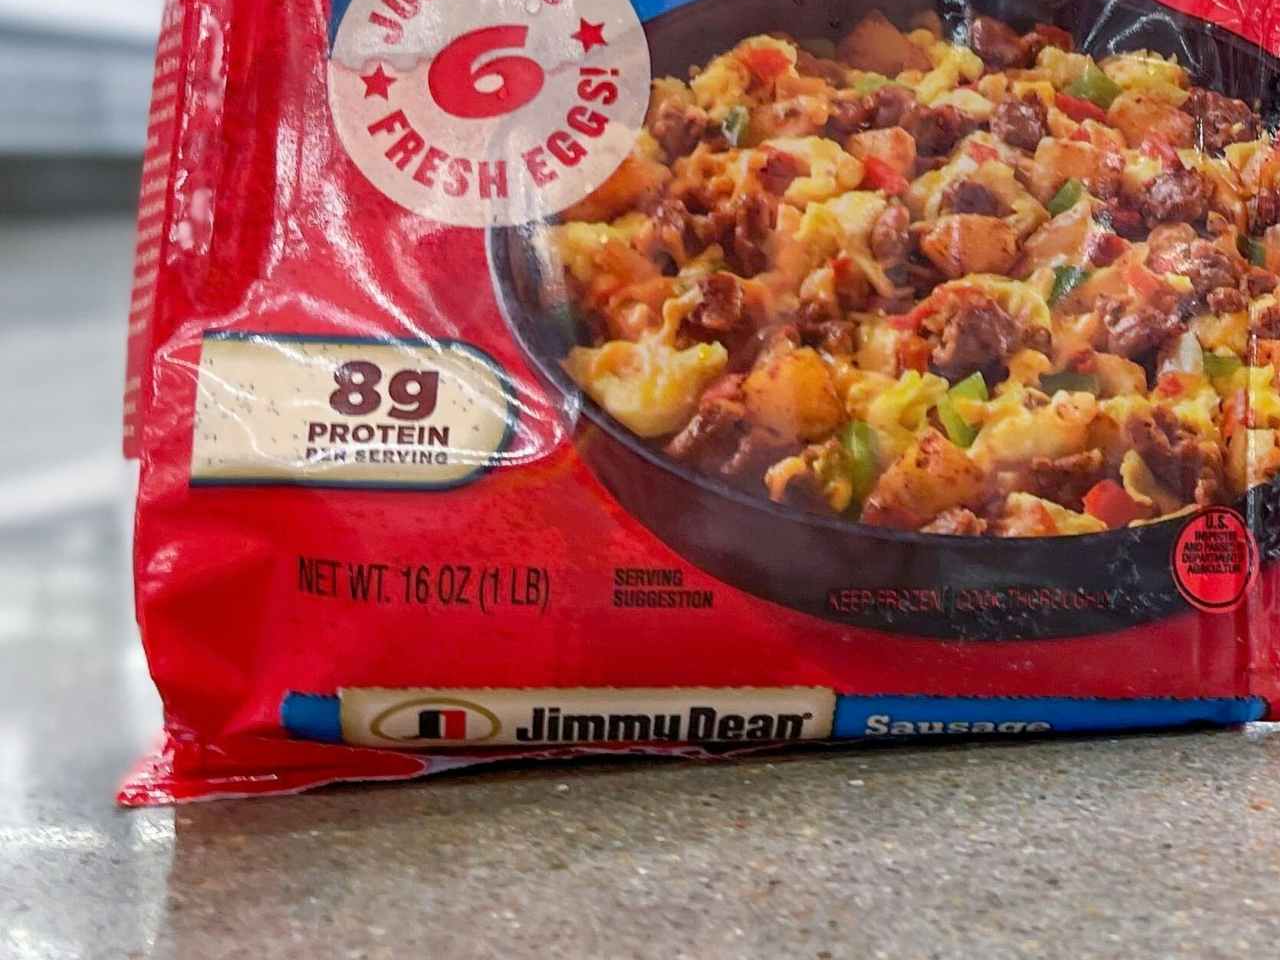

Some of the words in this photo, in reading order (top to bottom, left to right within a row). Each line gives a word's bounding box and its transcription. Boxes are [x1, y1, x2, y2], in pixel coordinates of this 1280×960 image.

[427, 24, 545, 119] 6
[367, 108, 508, 200] FRESH
[521, 66, 620, 189] EGGS!
[329, 360, 440, 422] 8g
[307, 422, 452, 446] PROTEIN
[355, 448, 449, 466] SERVING
[297, 556, 342, 598] NET
[347, 563, 391, 603] WT.
[402, 565, 431, 605] 16
[437, 565, 470, 605] OZ
[479, 566, 500, 614] (1
[511, 567, 550, 616] LB)
[613, 567, 684, 588] SERVING
[613, 589, 714, 610] SUGGESTION
[828, 588, 874, 613] KEEP
[516, 706, 681, 742] Jimmy
[865, 713, 1052, 736] Sausage
